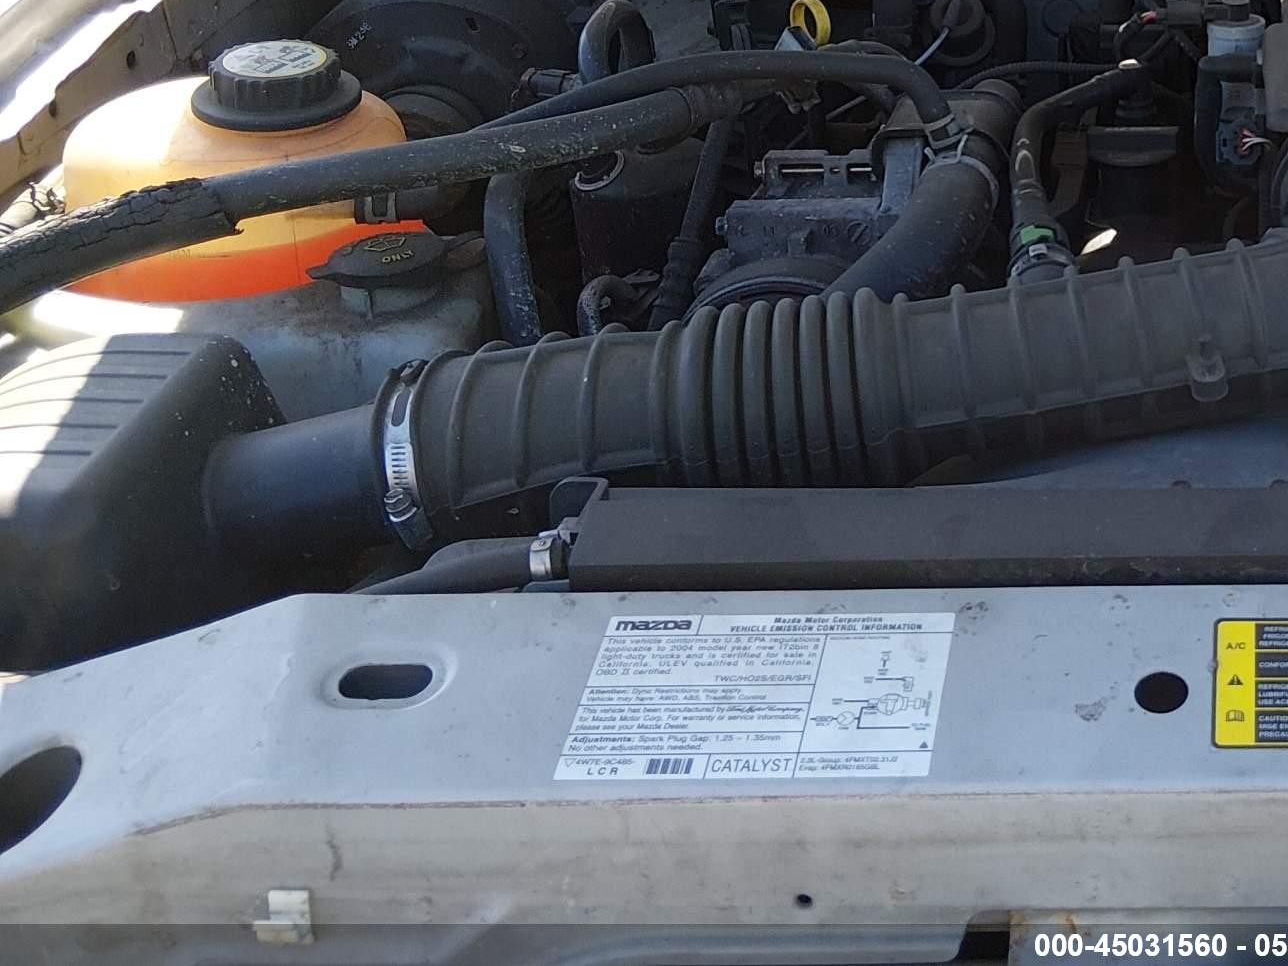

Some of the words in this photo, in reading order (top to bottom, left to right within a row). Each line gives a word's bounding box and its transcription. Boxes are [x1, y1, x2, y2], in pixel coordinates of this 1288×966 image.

[381, 249, 415, 263] ONLY
[615, 620, 693, 632] mazda
[730, 625, 767, 633] VEHICLE
[769, 624, 814, 632] EMISSION
[1225, 642, 1246, 650] A/C
[694, 660, 739, 668] qualified
[638, 735, 664, 743] Spark
[667, 735, 688, 743] Plug
[712, 758, 793, 773] CATALYST
